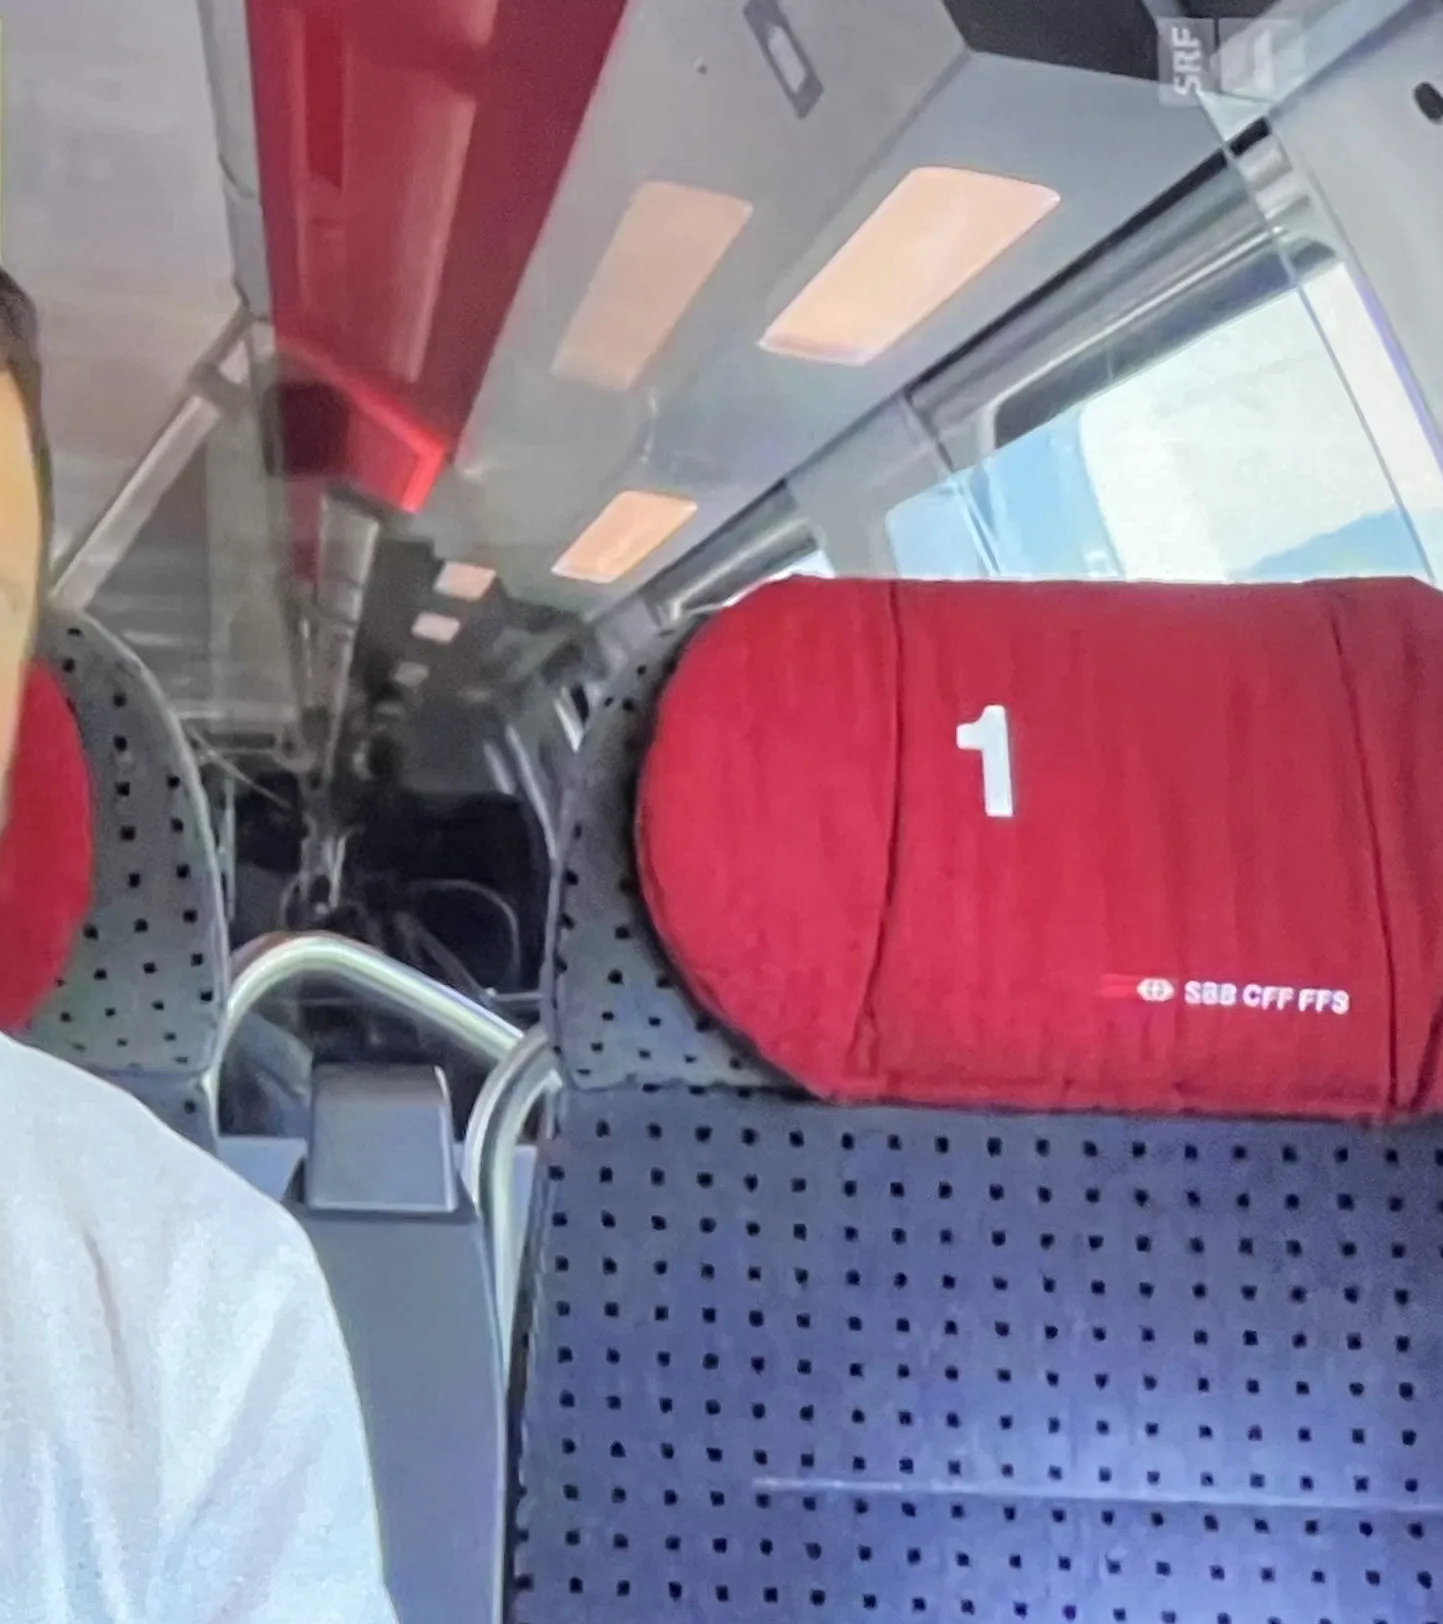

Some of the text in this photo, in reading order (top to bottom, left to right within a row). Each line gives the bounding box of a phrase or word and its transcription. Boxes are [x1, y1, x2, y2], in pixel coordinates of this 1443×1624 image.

[957, 704, 1013, 817] 1
[1184, 980, 1349, 1015] SBB CFF FFS
